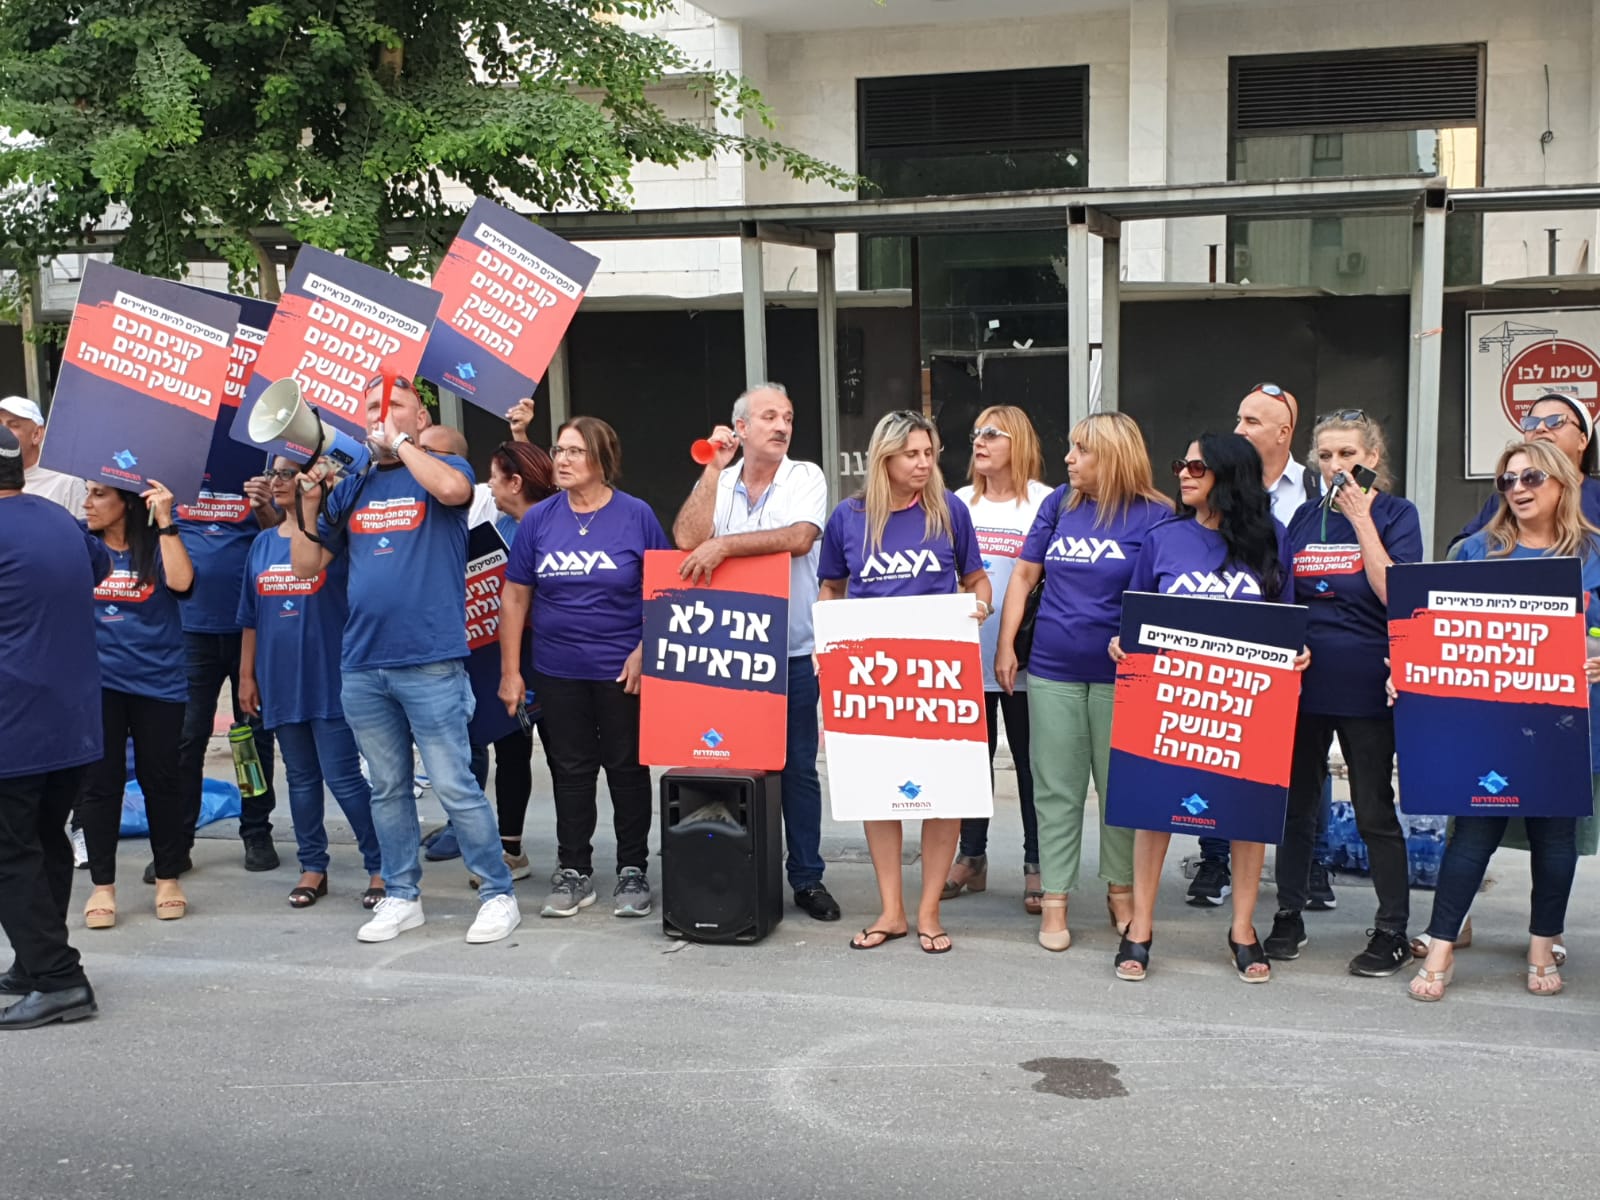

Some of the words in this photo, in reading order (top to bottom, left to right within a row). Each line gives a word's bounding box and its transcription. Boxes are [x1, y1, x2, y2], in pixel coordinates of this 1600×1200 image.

[482, 229, 517, 255] פראיירים
[476, 249, 514, 281] חכם
[516, 253, 540, 270] להיות
[310, 279, 350, 303] פראיירים
[512, 272, 558, 309] קונים
[540, 265, 575, 293] מפסיקים
[120, 297, 159, 317] פראיירים
[351, 299, 377, 316] להיות
[470, 271, 539, 321] ונלחמים
[112, 314, 152, 340] חכם
[160, 311, 184, 326] להיות
[307, 301, 349, 333] חכם
[378, 310, 419, 335] מפסיקים
[462, 293, 524, 337] בעושק
[185, 321, 223, 342] מפסיקים
[349, 321, 401, 356] קונים
[451, 308, 515, 357] המחיה!
[112, 335, 188, 376] ונלחמים
[153, 331, 203, 361] קונים
[230, 343, 258, 365] קונ
[303, 326, 381, 372] ונלחמים
[77, 342, 148, 382] המחיה!
[298, 351, 367, 392] בעושק
[1518, 363, 1544, 380] לב!
[1550, 364, 1593, 379] שימו
[149, 371, 212, 406] בעושק
[468, 554, 503, 573] מפסיקים
[1435, 595, 1483, 607] פראיירים
[1487, 597, 1517, 609] להיות
[1519, 600, 1569, 613] מפסיקים
[668, 600, 714, 635] לא
[721, 609, 771, 643] אני
[1434, 618, 1482, 638] חכם
[1147, 629, 1199, 649] פראיירים
[1487, 622, 1549, 646] קונים
[656, 638, 777, 683] פראייר!
[1200, 641, 1234, 657] להיות
[1236, 645, 1288, 664] מפסיקים
[1441, 642, 1535, 666] ונלחמים
[848, 651, 899, 686] לא
[907, 658, 963, 690] אני
[1153, 655, 1203, 681] חכם
[1207, 664, 1272, 696] קונים
[1405, 662, 1490, 688] המחיה!
[1494, 671, 1576, 694] בעושק
[832, 690, 980, 725] פראיירית!
[1156, 682, 1254, 717] ונלחמים
[1160, 710, 1243, 743] בעושק
[1153, 734, 1241, 770] המחיה!
[1471, 796, 1520, 804] ההסתדרות
